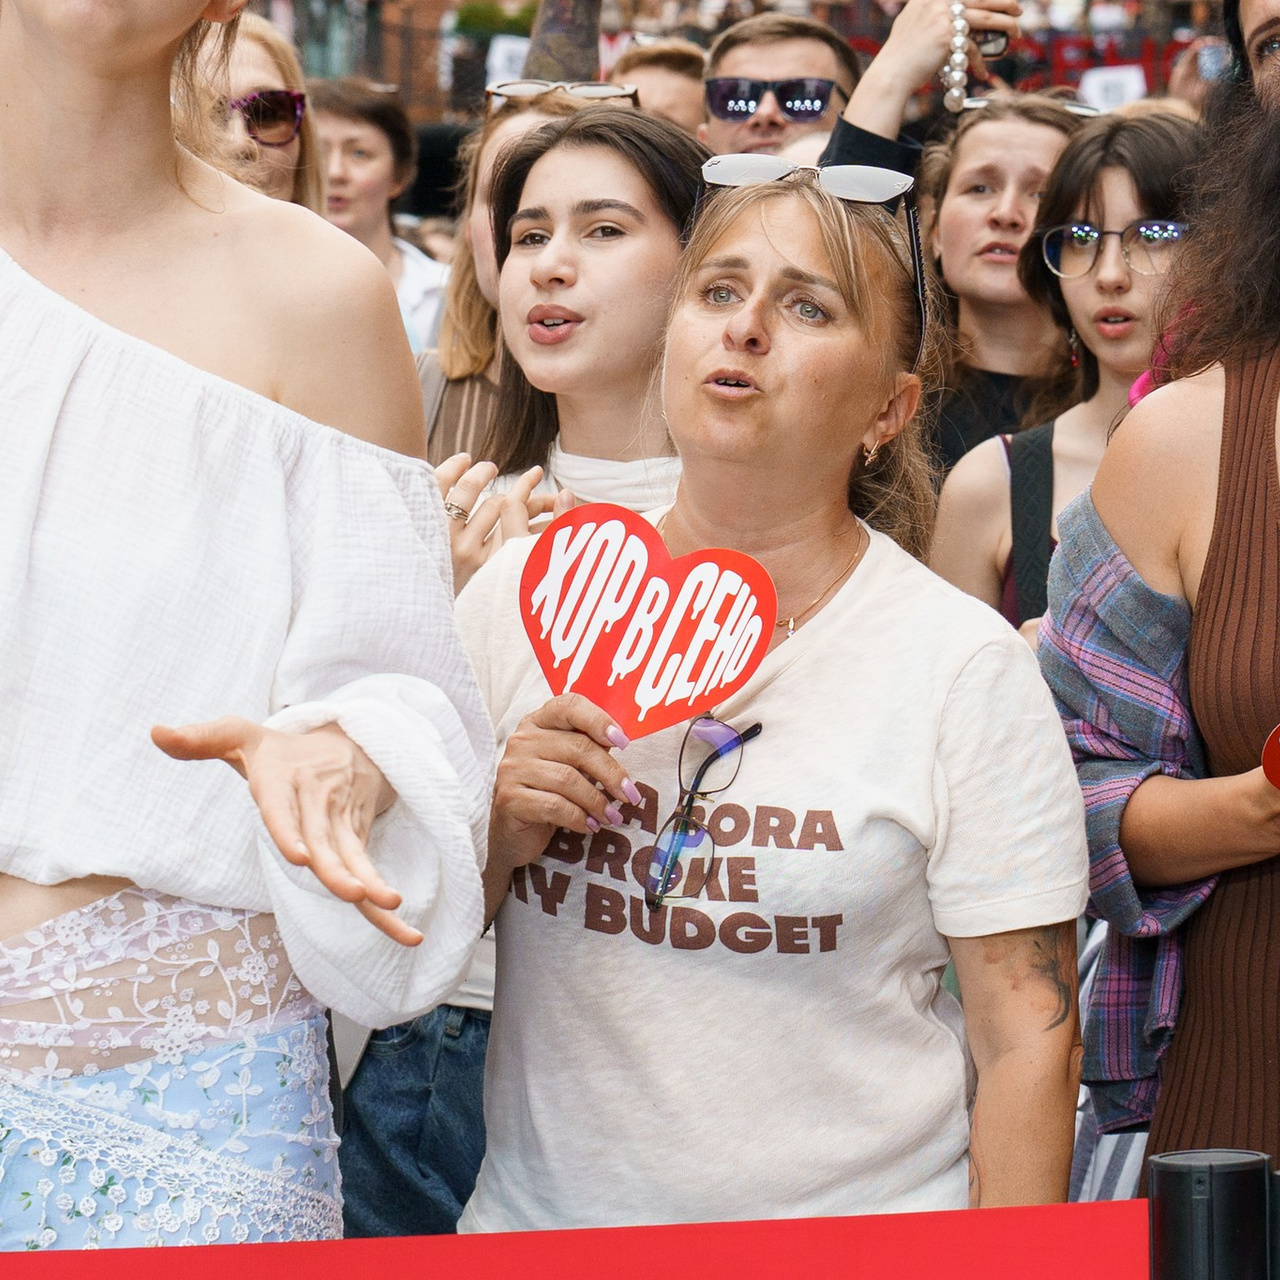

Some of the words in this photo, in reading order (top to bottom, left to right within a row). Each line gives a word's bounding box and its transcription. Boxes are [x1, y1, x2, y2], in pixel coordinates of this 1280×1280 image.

[531, 519, 649, 694] ХОР
[634, 561, 763, 722] СЕНО
[542, 824, 759, 903] BROKE
[583, 881, 843, 955] BUDGET
